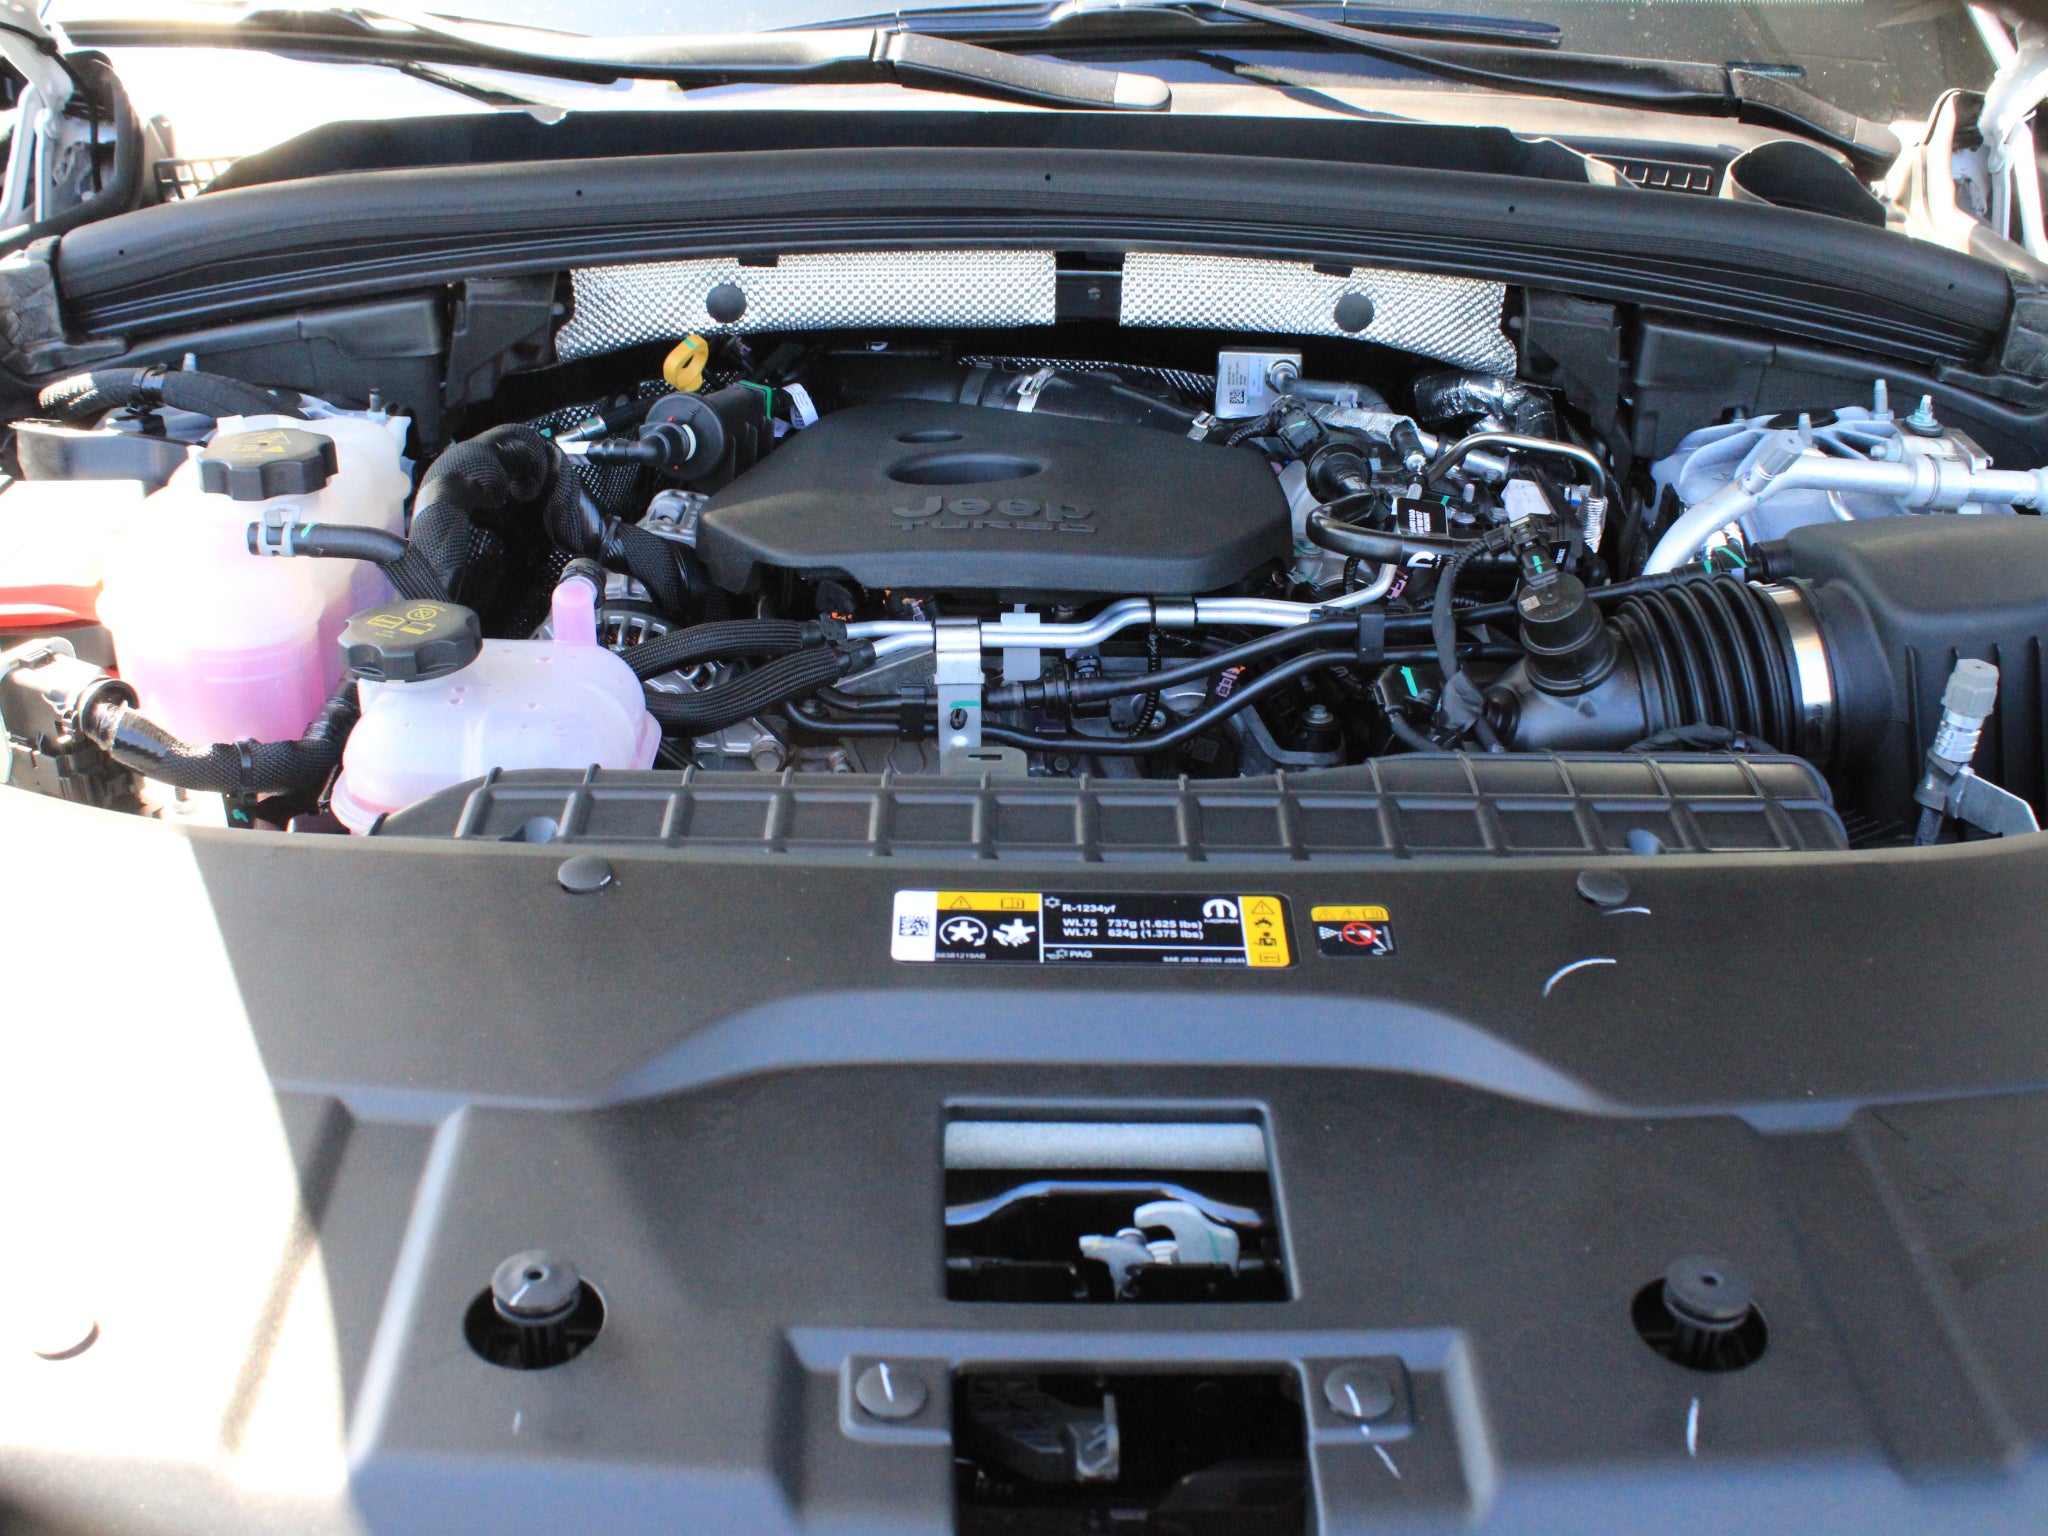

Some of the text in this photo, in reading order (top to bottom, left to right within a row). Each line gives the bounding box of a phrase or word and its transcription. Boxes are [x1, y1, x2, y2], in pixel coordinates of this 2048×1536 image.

[891, 495, 1093, 522] Jeep
[1062, 904, 1116, 914] R-1234yf
[1063, 918, 1203, 930] WL75 737g (1.625 lbs)
[1063, 928, 1204, 940] WL74 624g (1.375 lbs)
[1069, 950, 1093, 959] PAG
